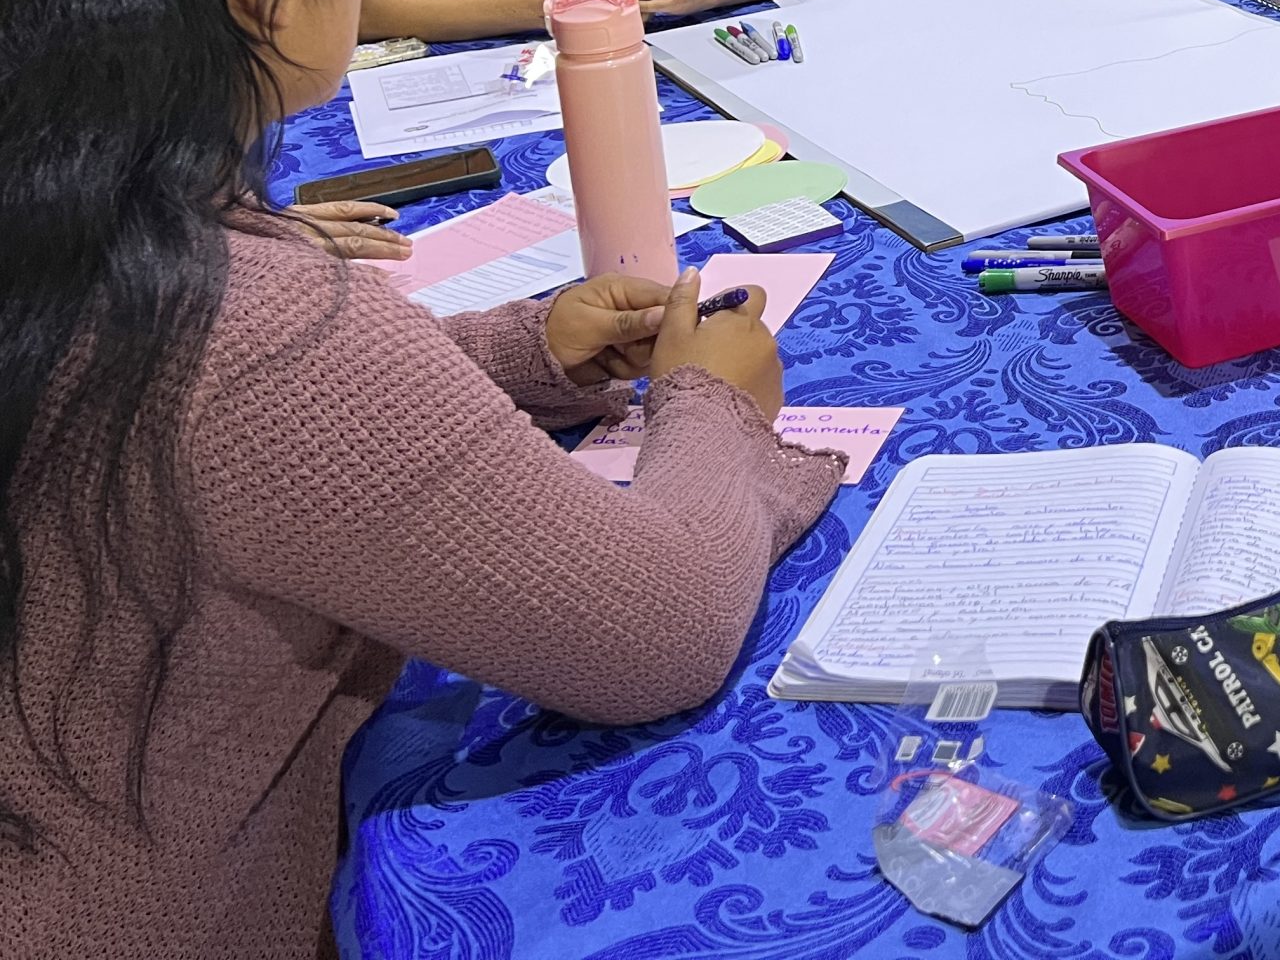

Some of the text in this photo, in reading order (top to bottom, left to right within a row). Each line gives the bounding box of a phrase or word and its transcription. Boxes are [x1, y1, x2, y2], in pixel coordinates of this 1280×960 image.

[1034, 268, 1083, 283] Sharpie
[592, 433, 630, 445] das
[1187, 624, 1214, 654] CA
[1208, 650, 1262, 730] PATROL
